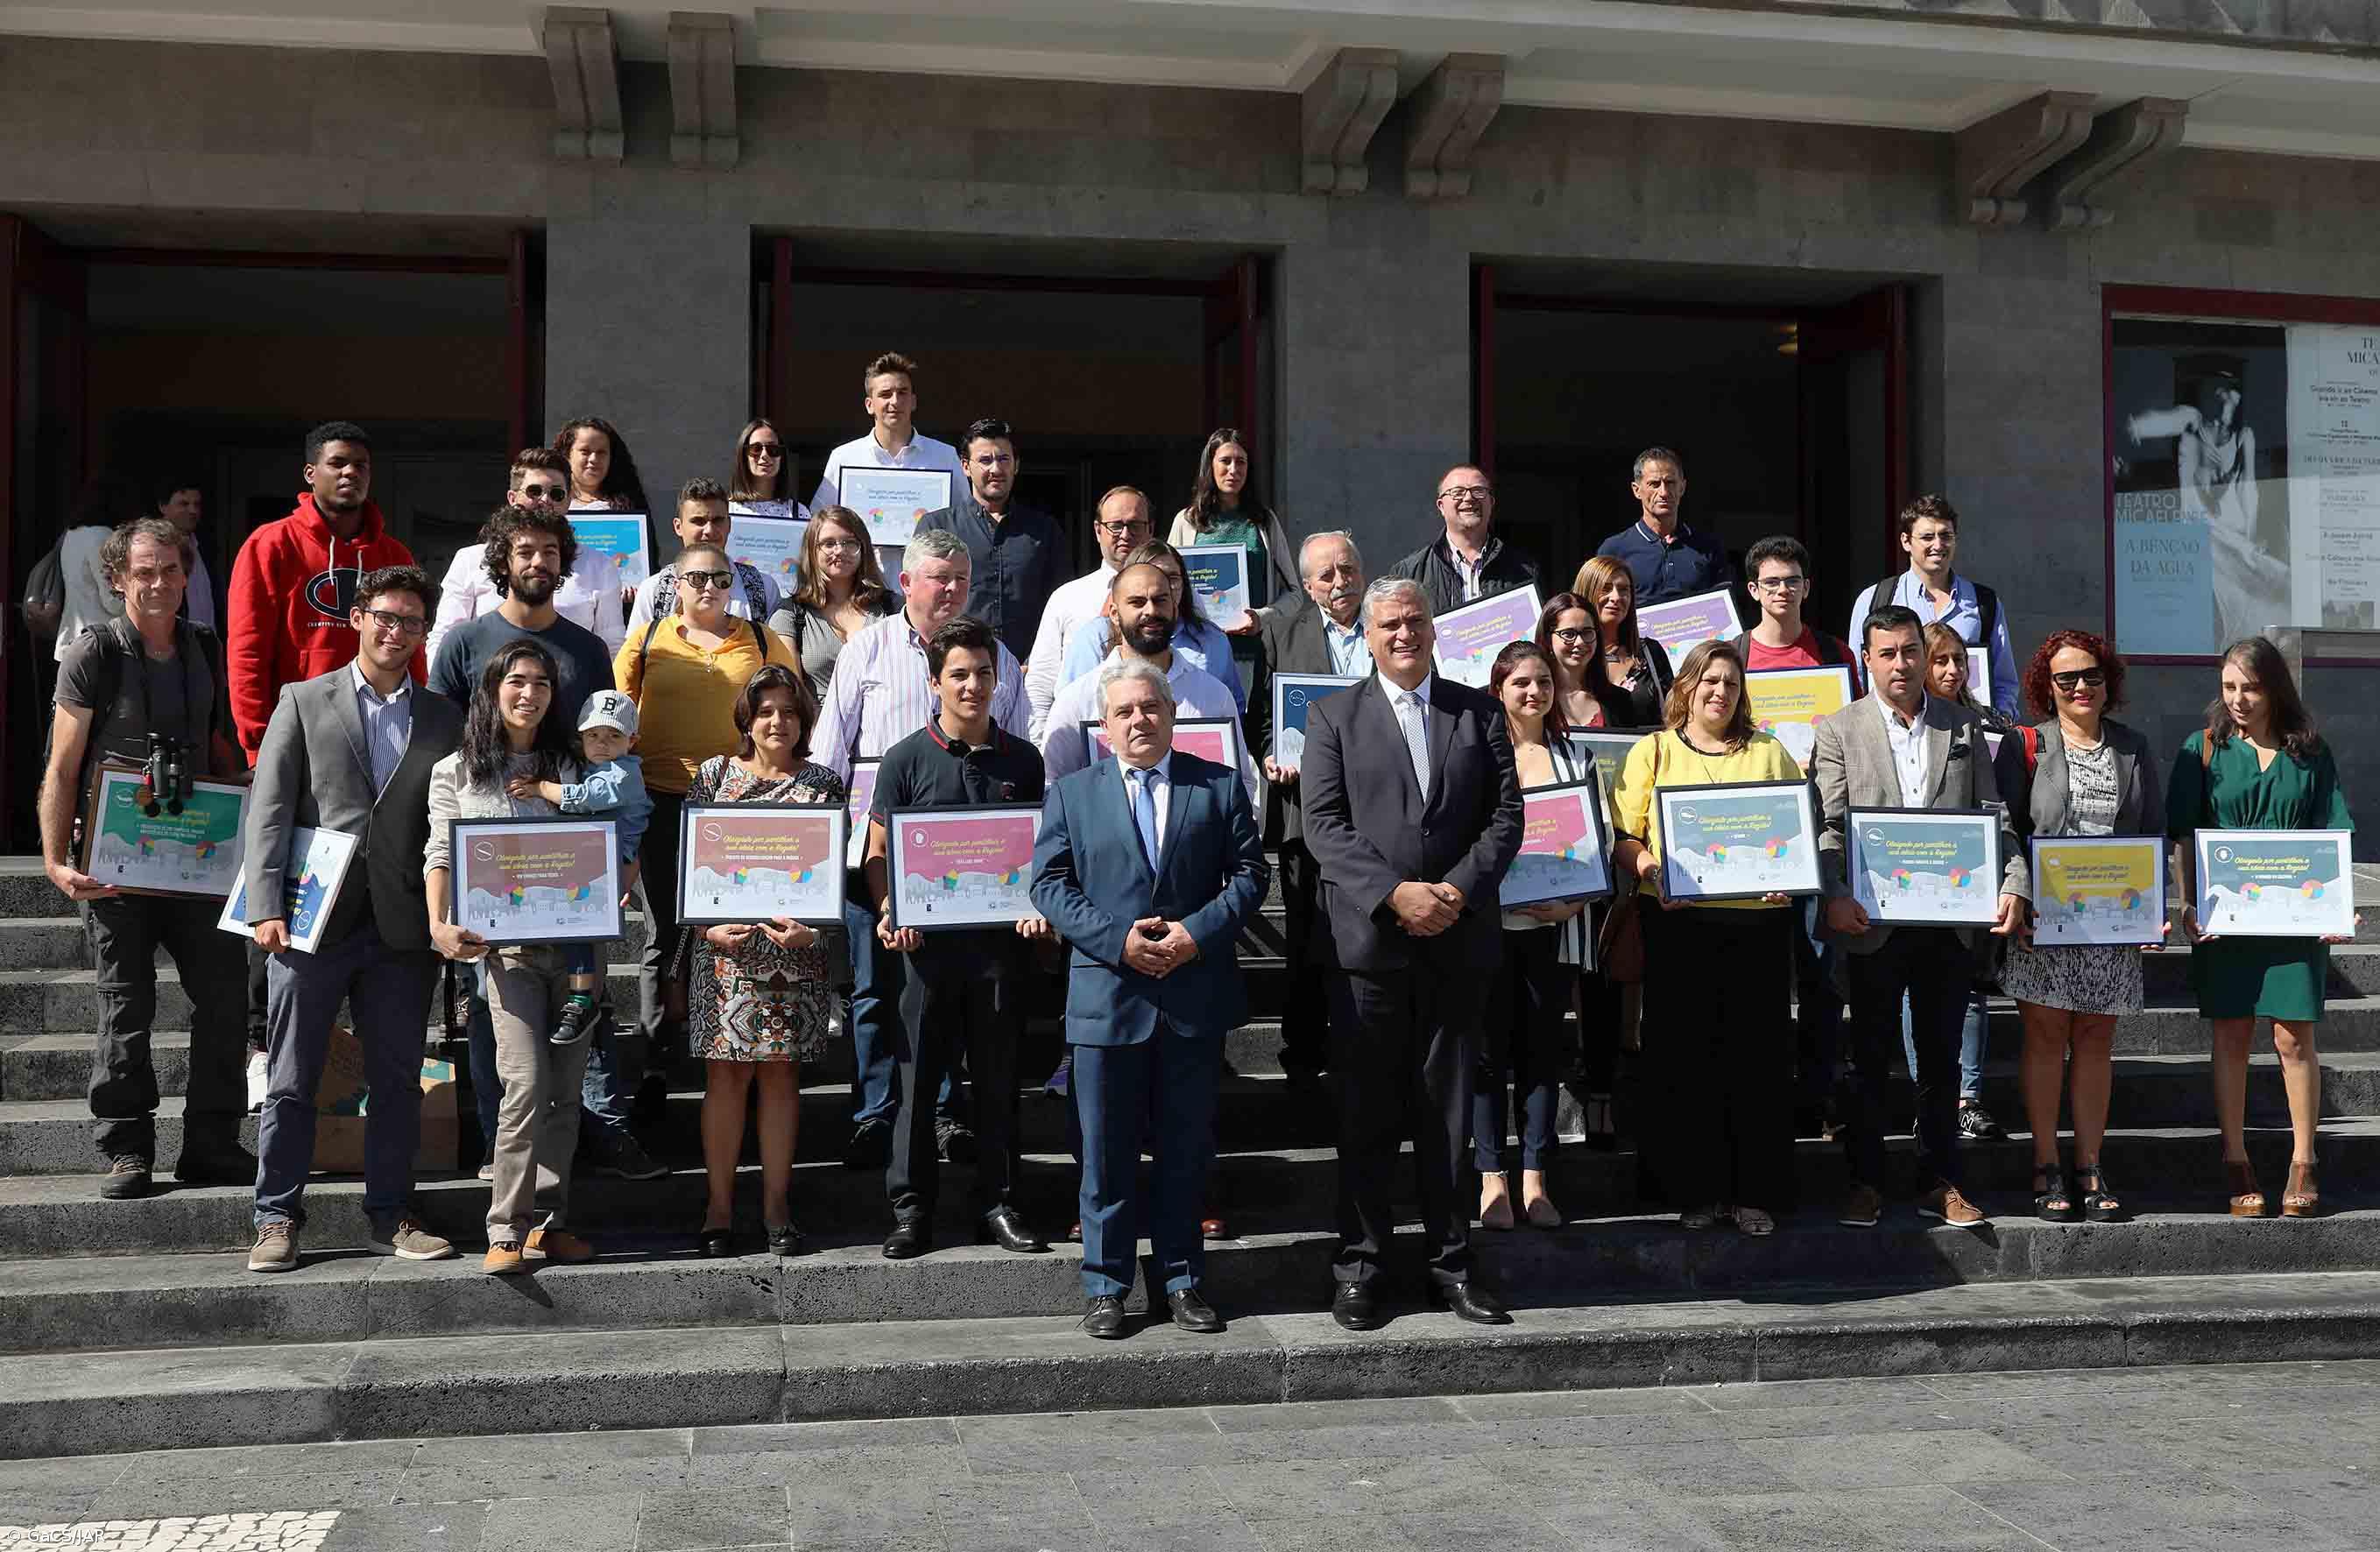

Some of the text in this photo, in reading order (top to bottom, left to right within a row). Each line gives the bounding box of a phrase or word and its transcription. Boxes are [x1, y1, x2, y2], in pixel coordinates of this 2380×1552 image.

[2115, 492, 2176, 509] TEATRO
[2130, 561, 2151, 575] DA
[602, 697, 617, 710] B
